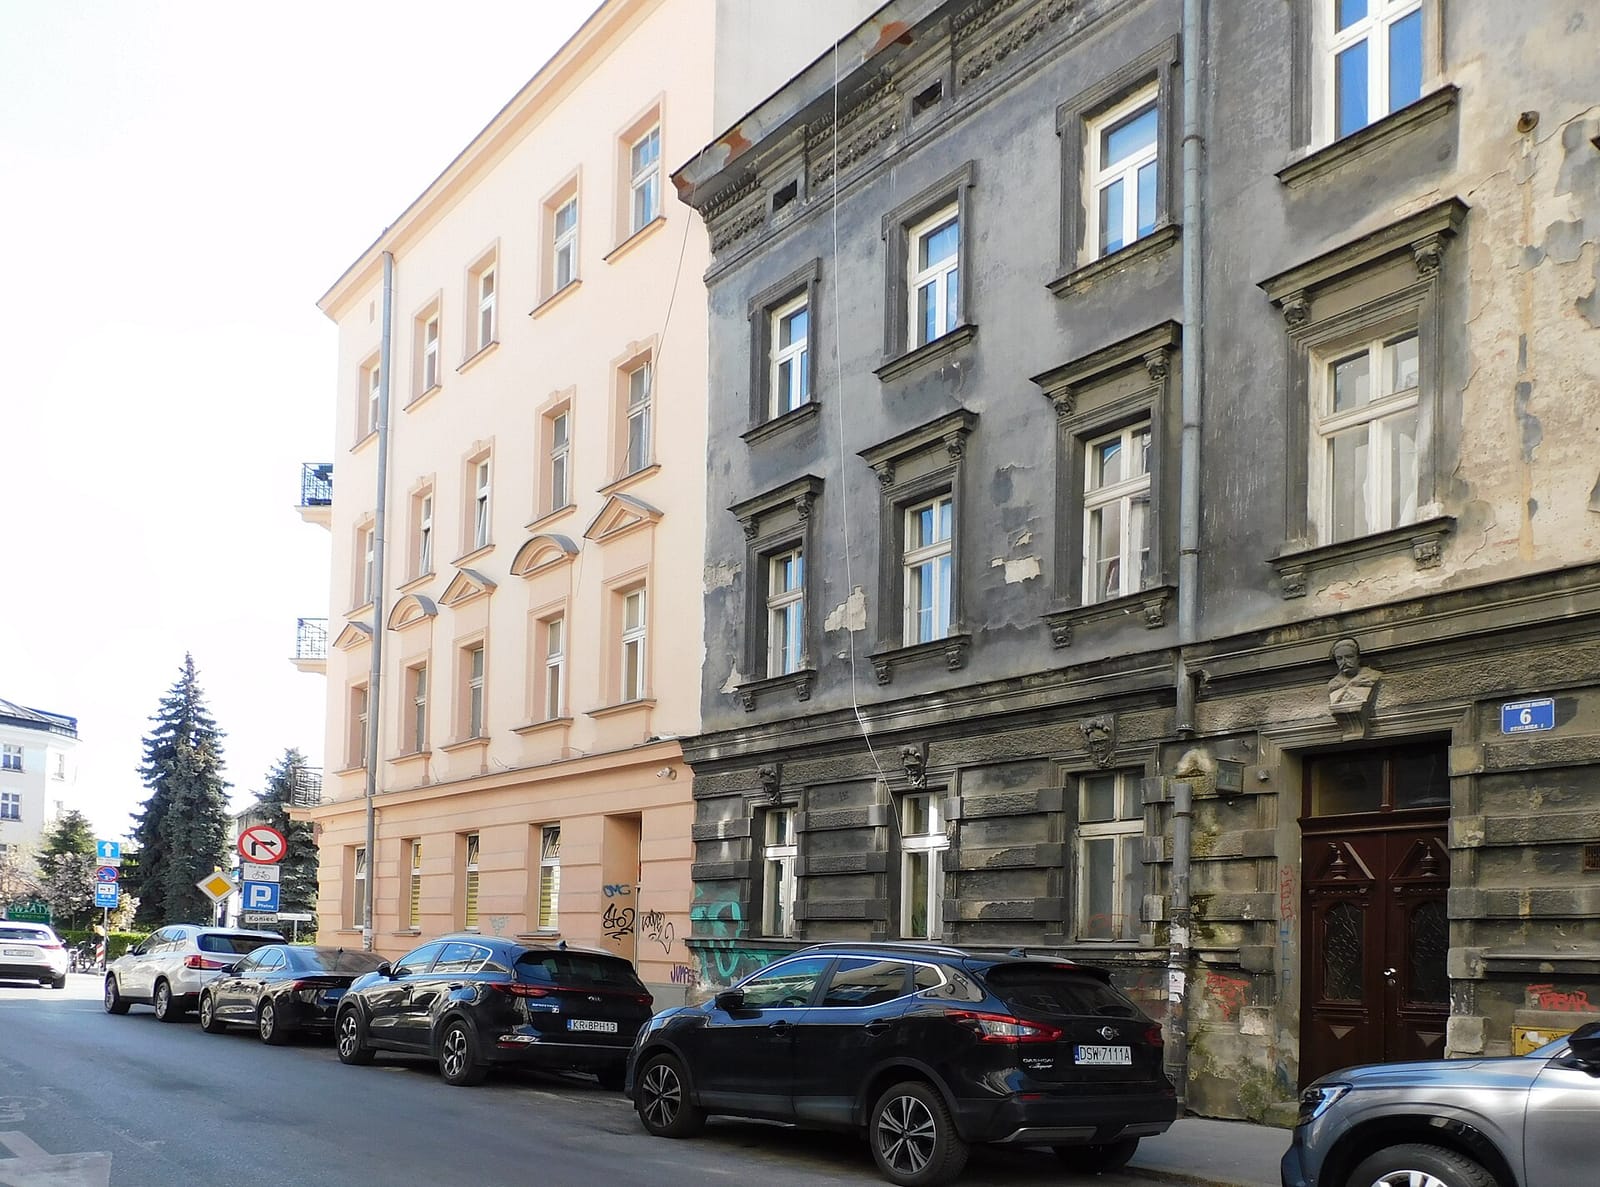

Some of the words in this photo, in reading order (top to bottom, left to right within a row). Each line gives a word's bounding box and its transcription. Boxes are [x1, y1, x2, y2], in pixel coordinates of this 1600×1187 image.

[1520, 708, 1532, 724] 6
[250, 885, 272, 908] P
[248, 914, 275, 922] Koniec
[573, 1020, 585, 1029] KR
[1080, 1046, 1099, 1061] DSW
[1101, 1047, 1130, 1061] 7111A
